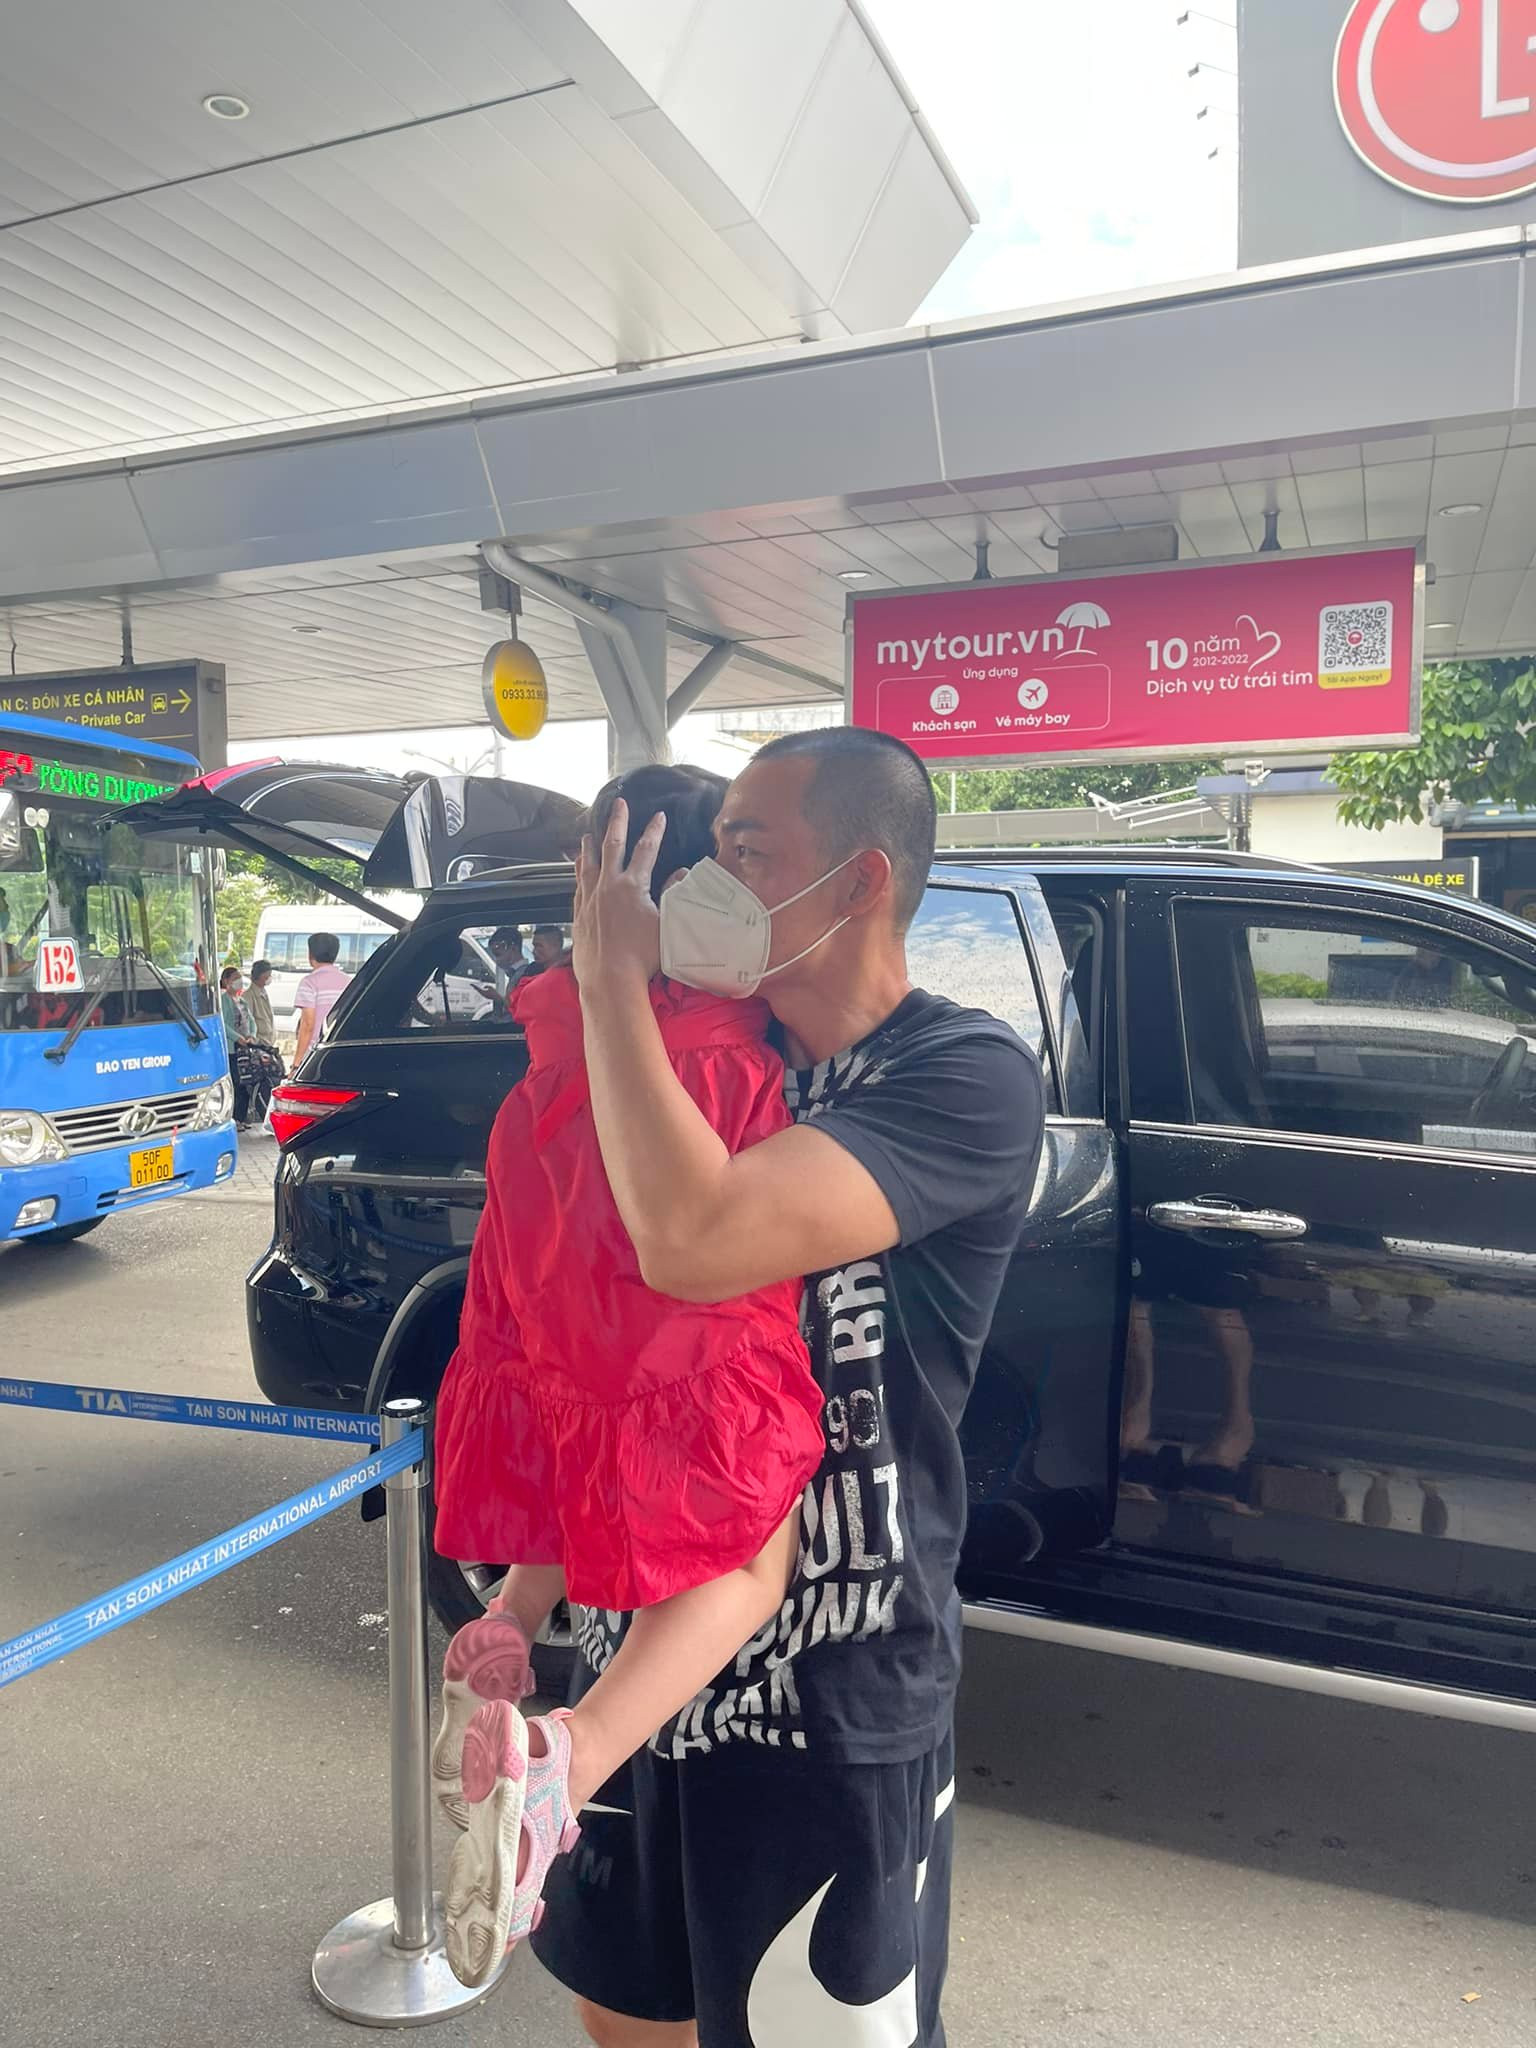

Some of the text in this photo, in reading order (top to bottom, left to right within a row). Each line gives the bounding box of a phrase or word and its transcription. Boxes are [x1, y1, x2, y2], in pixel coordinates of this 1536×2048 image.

[1481, 0, 1536, 118] L
[877, 627, 1064, 671] mytour.vn
[1146, 635, 1240, 671] 10 năm
[1193, 654, 1248, 667] 2012-2022
[988, 666, 1018, 679] dụng
[1147, 670, 1313, 698] Dịch vụ từ trái tim
[15, 698, 29, 711] C:
[32, 693, 60, 710] ĐÓN
[64, 694, 80, 707] XE
[84, 689, 103, 705] CÁ
[106, 686, 145, 704] NHÂN
[81, 713, 121, 727] Private
[125, 711, 146, 724] Car
[912, 719, 977, 732] Khách sạn
[995, 713, 1070, 728] Vé máy bay
[1446, 874, 1465, 886] XE
[43, 945, 76, 985] 152
[96, 1055, 171, 1074] BAO YEN GROUP
[143, 1150, 161, 1166] 50F
[136, 1164, 169, 1184] 011.00
[76, 1390, 127, 1413] TIA
[186, 1403, 213, 1419] TAN
[217, 1406, 247, 1423] SON
[250, 1411, 289, 1428] NHAT
[84, 1460, 383, 1630] TAN SON NHAT INTERNATIONAL AIRPORT
